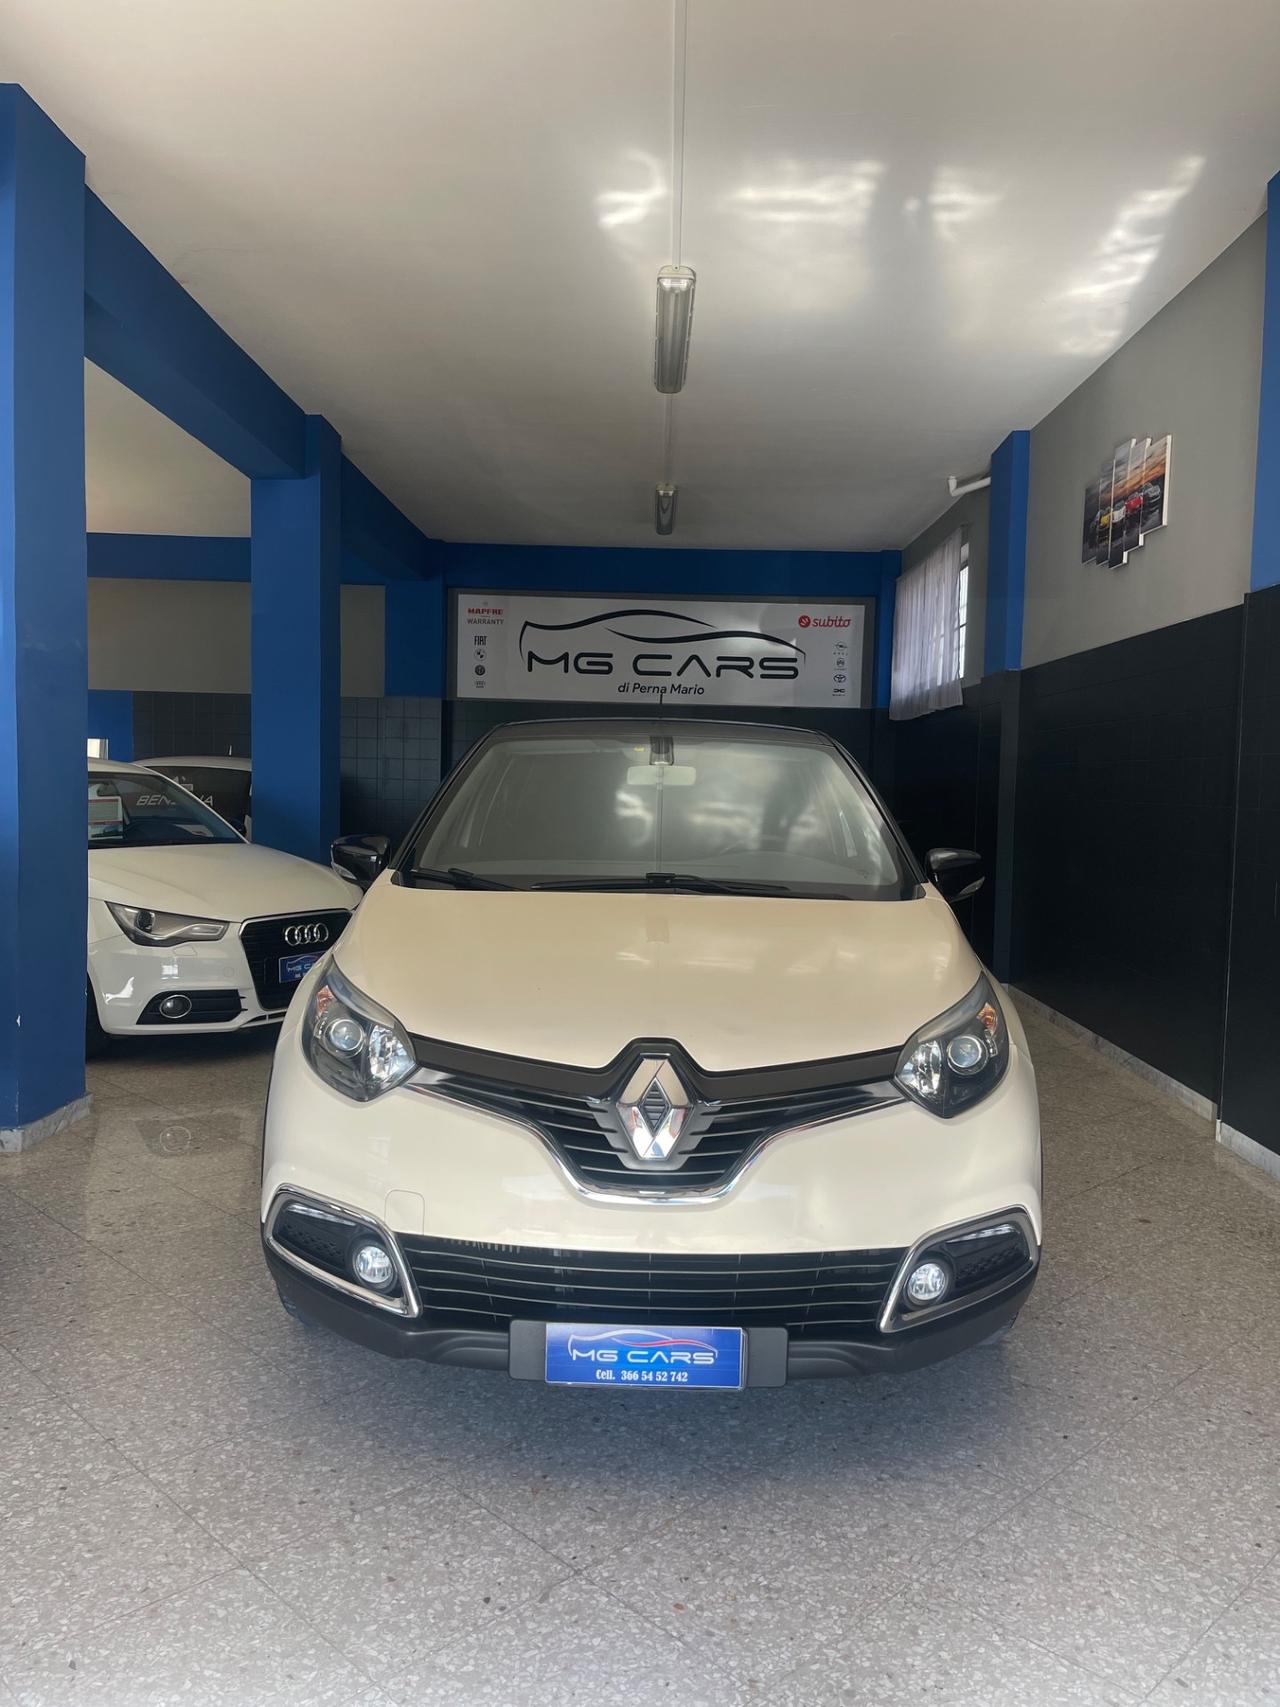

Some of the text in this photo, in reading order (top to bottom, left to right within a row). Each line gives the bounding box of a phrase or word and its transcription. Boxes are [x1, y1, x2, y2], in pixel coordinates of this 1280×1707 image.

[812, 616, 851, 628] subito
[474, 635, 487, 646] FIAT
[527, 650, 799, 680] MG CARS
[618, 683, 705, 696] di Perna Mario
[573, 1349, 714, 1365] MG CARS
[596, 1369, 688, 1382] Cell. 366 54 52 742
